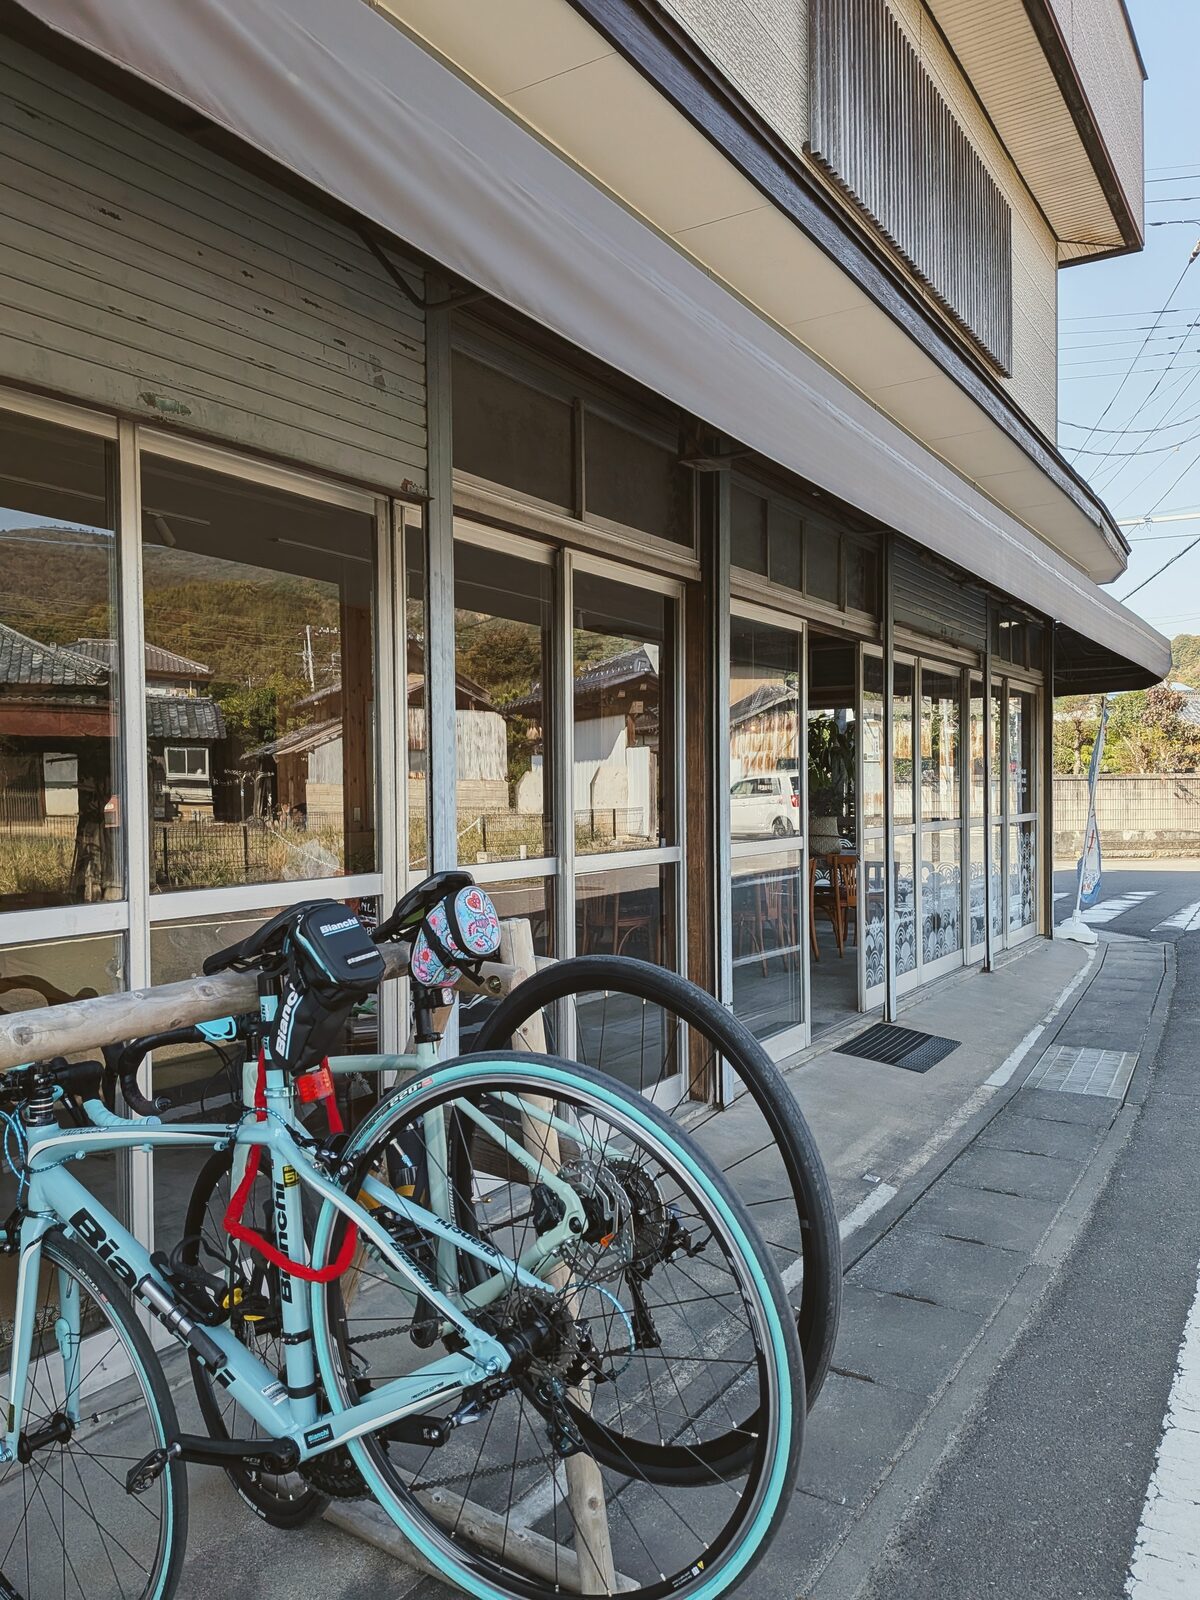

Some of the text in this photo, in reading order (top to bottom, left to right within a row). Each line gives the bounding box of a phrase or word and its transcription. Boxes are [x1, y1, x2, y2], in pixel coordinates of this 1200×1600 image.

[319, 916, 359, 935] Bianchi
[275, 983, 299, 1057] Bianc
[275, 1181, 293, 1304] Binchi
[434, 1217, 498, 1258] Bianchi
